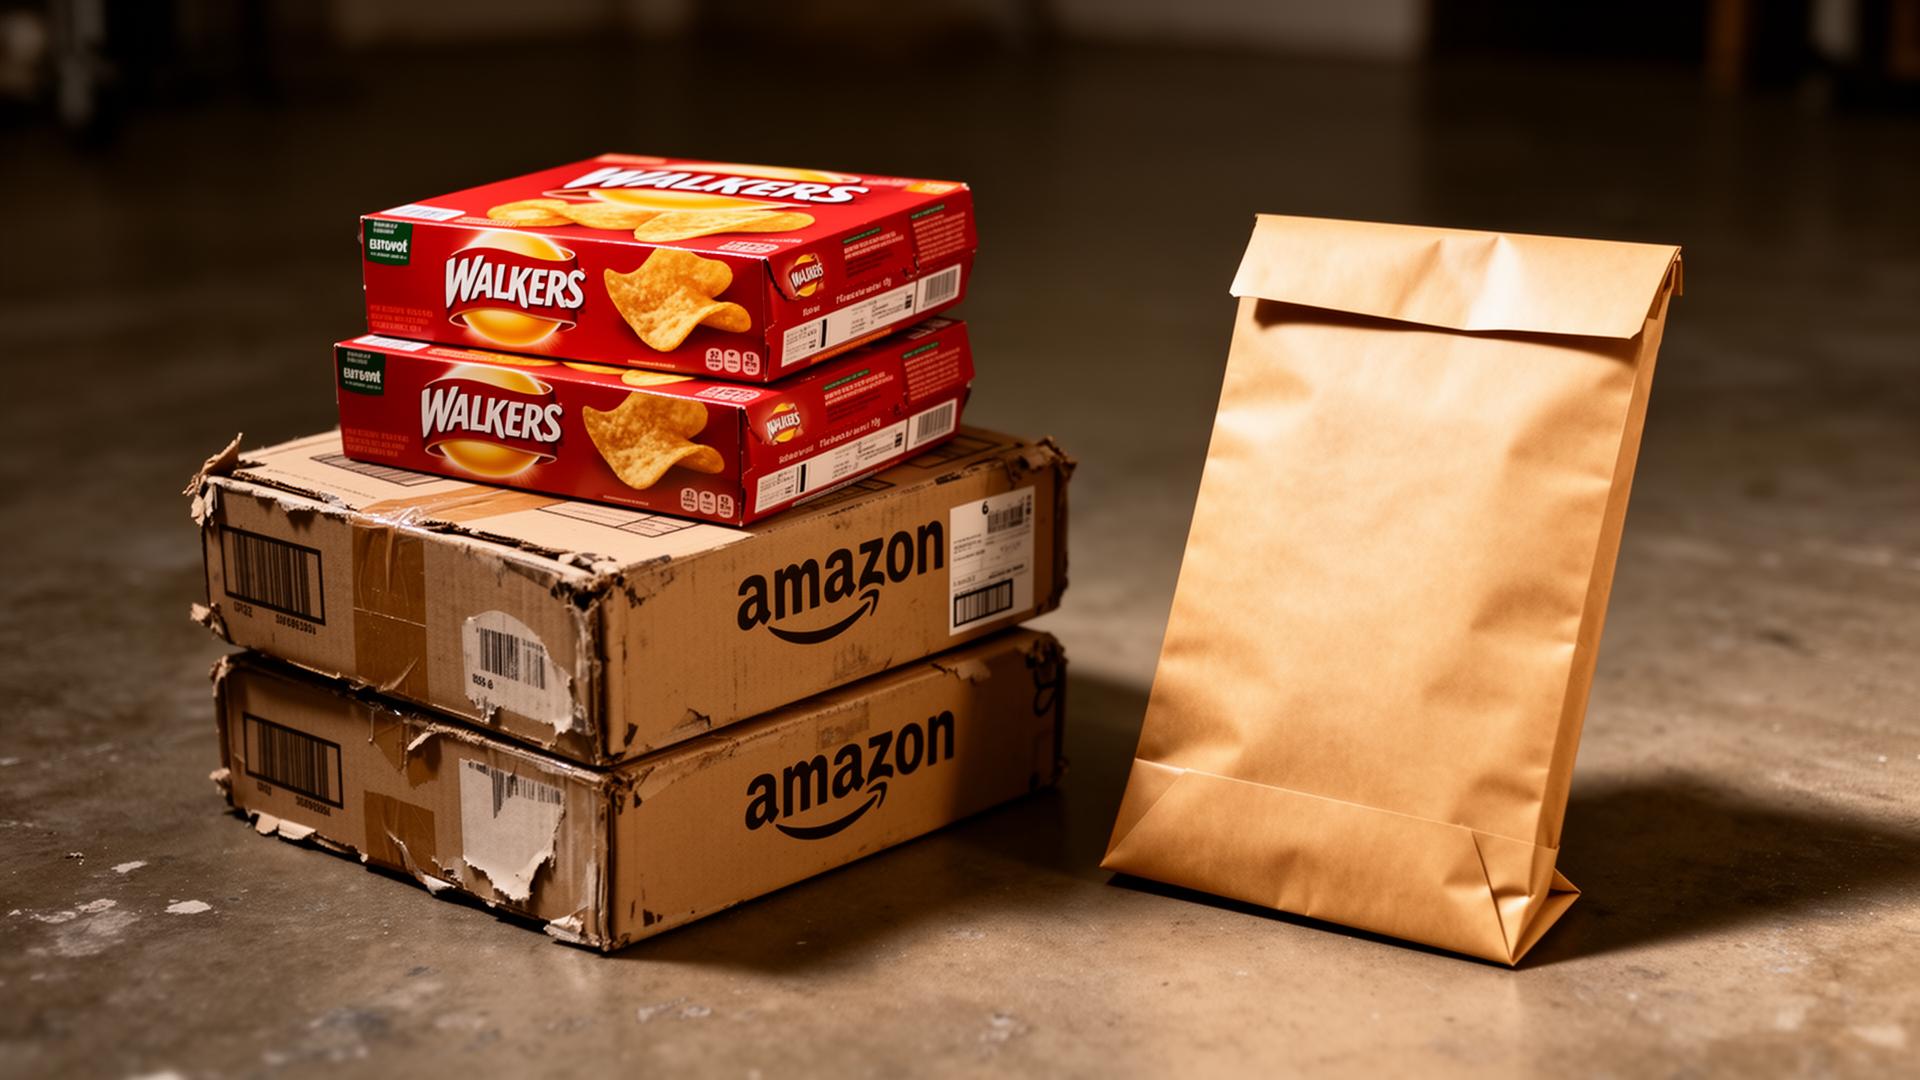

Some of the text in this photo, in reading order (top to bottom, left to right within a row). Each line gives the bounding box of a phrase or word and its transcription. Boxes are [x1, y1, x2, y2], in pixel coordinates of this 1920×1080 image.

[563, 167, 869, 203] WALKERS
[446, 255, 586, 308] WALKERS
[421, 386, 563, 442] WALKERS
[981, 501, 989, 515] 6
[737, 520, 944, 631] amazon
[745, 710, 955, 830] amazon
